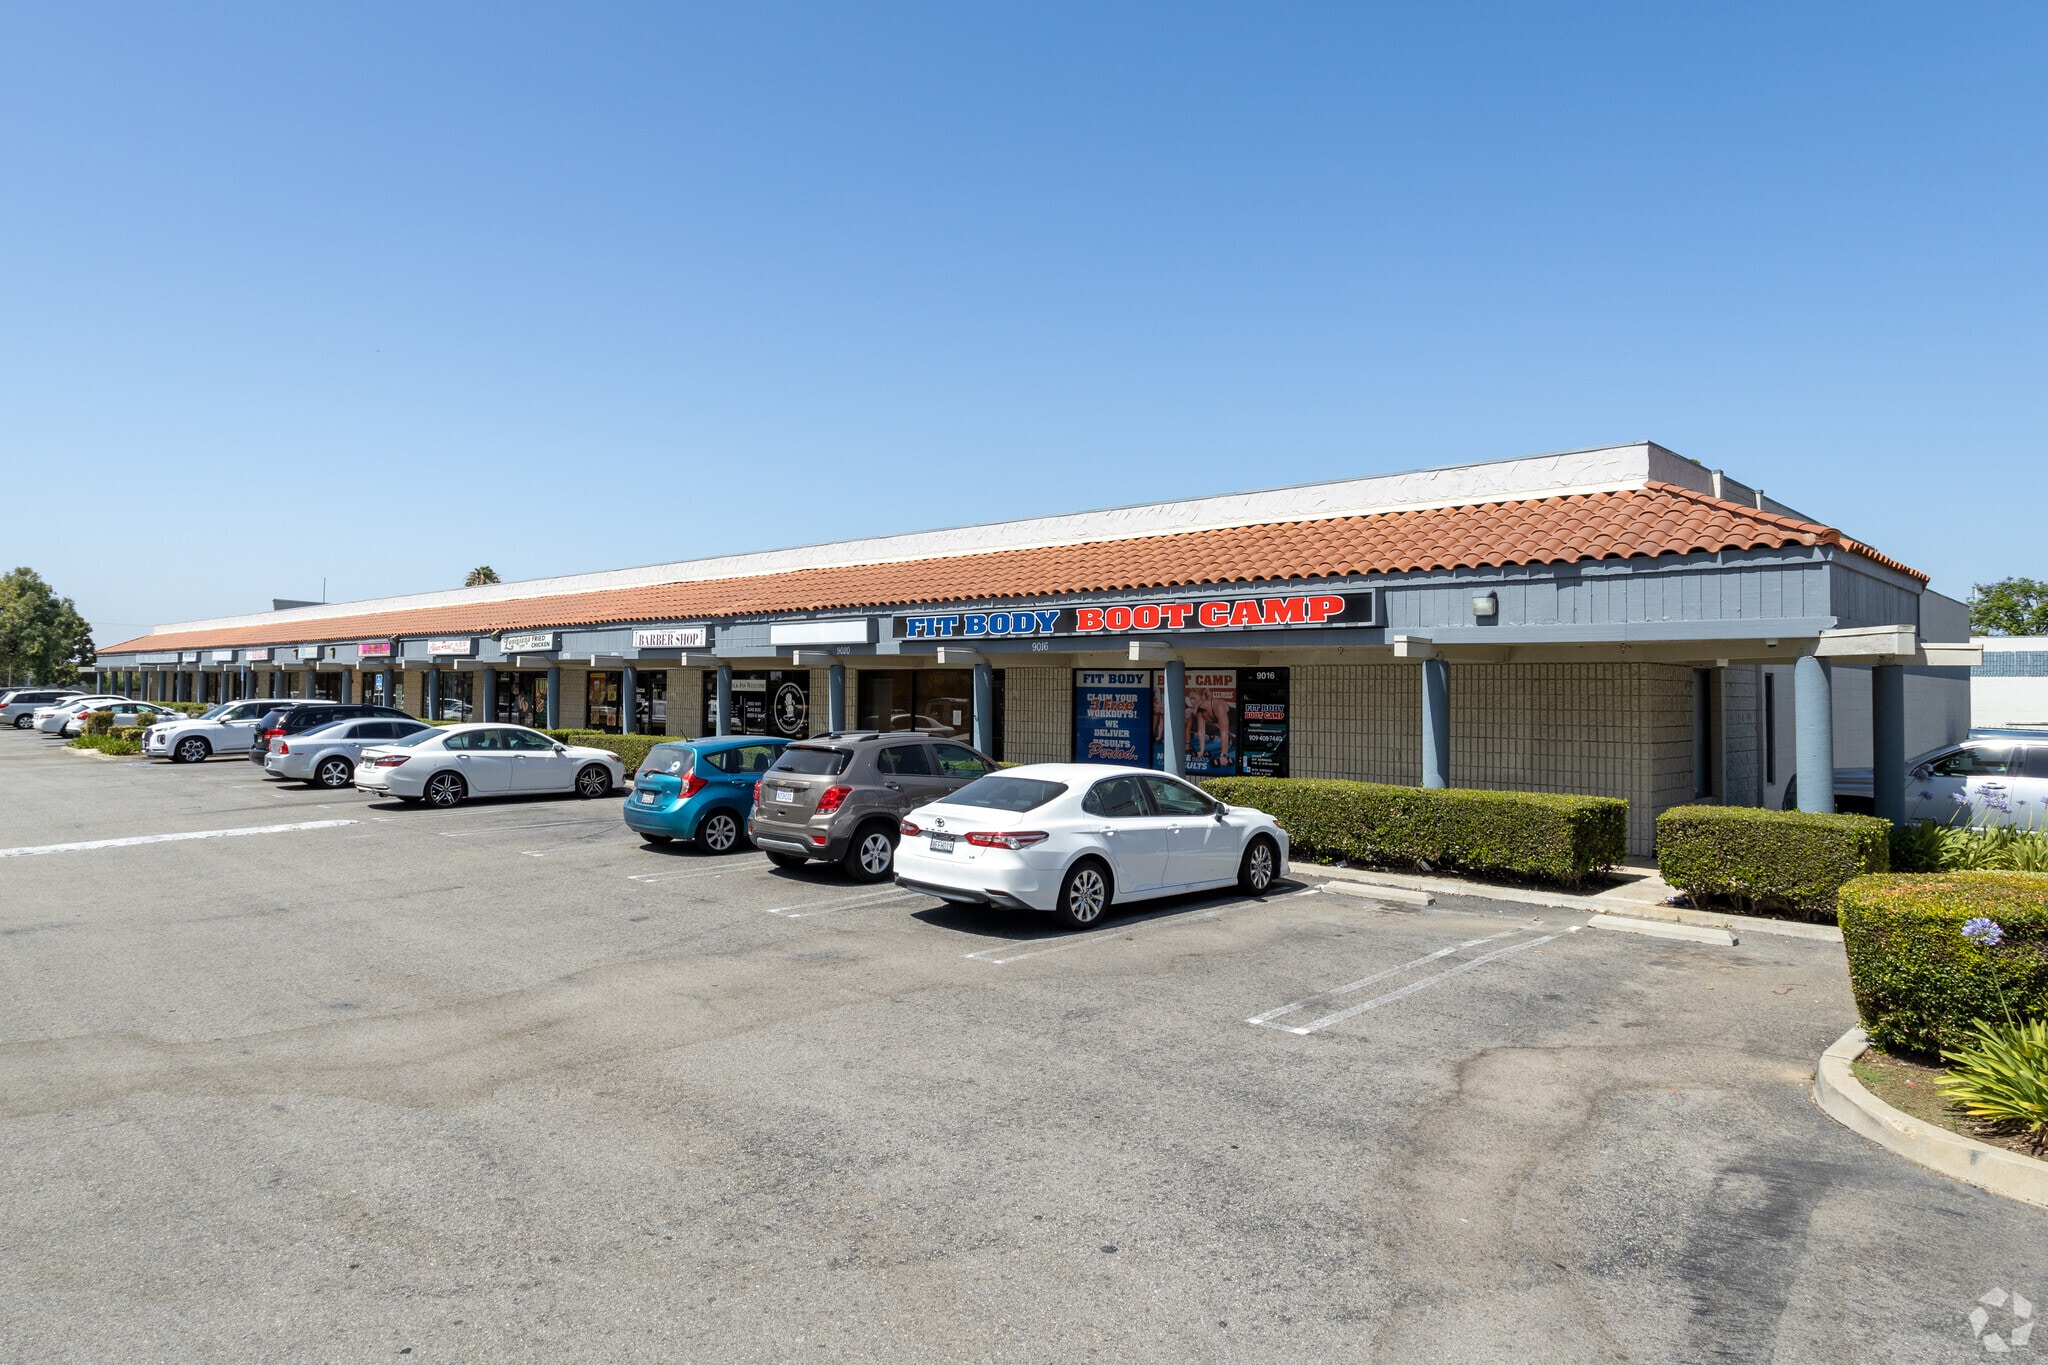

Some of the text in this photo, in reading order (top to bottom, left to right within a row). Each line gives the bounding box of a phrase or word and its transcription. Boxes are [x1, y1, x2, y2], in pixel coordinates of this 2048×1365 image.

[906, 595, 1345, 638] FIT BODY BOOT CAMP
[532, 635, 546, 643] FRIED
[638, 633, 674, 646] BARBER
[676, 631, 699, 646] SHOP
[531, 641, 551, 649] CHICKEN
[1032, 642, 1049, 652] 9016
[1083, 673, 1144, 684] FIT BODY
[1195, 675, 1233, 686] CAMP
[1256, 671, 1275, 680] 9016
[1087, 693, 1138, 702] CLAIM YOUR
[1090, 699, 1135, 711] 3 Free
[1245, 703, 1285, 713] FIT BODY
[1087, 709, 1138, 719] WORKOUTS!
[1245, 711, 1285, 720] BOOT CAMP
[1105, 720, 1119, 729] WE
[1094, 729, 1130, 738] DELIVER
[1093, 739, 1131, 749] RESULTS
[1088, 742, 1139, 760] Period.
